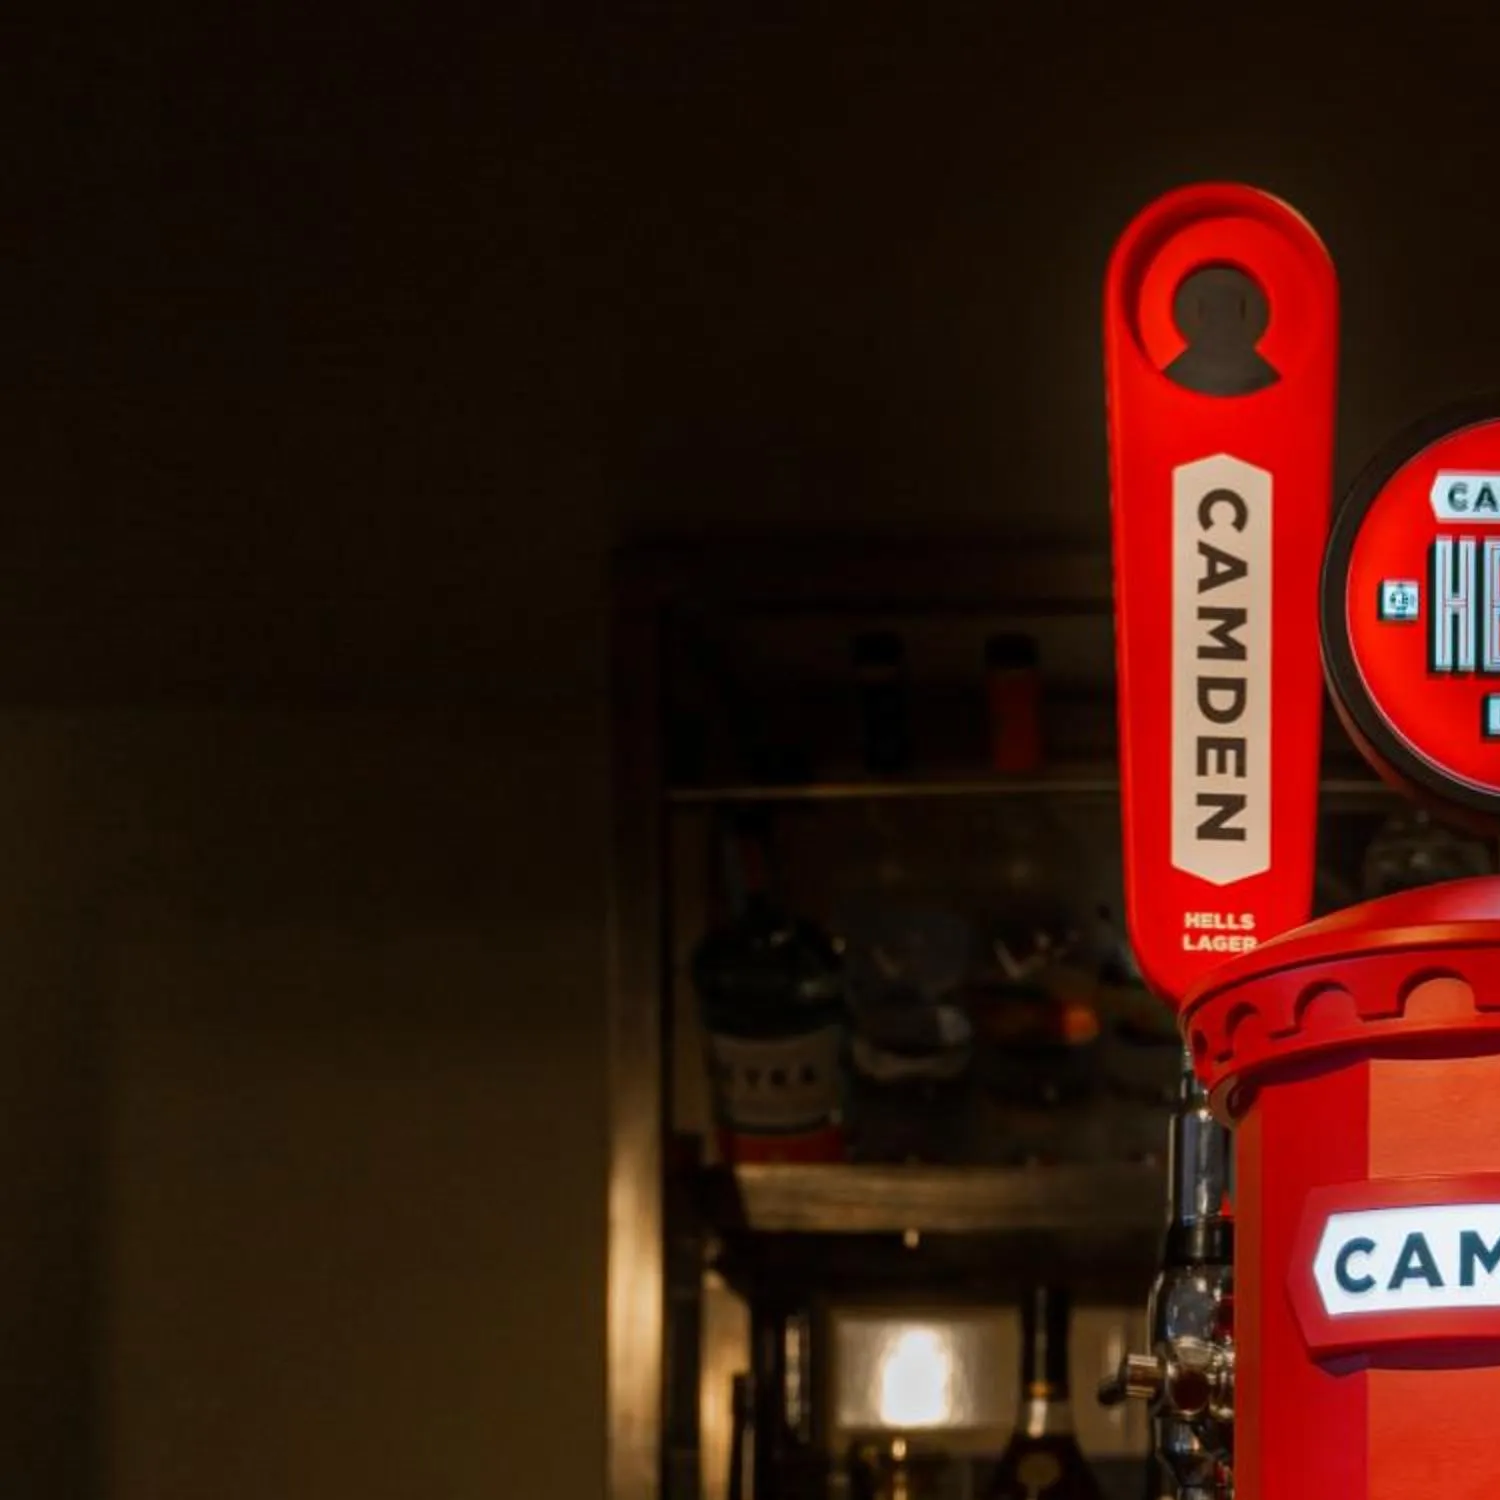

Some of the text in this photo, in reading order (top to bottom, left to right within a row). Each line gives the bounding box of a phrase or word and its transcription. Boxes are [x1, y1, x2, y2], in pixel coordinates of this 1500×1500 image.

[1196, 487, 1249, 842] CAMDEN
[1183, 911, 1256, 930] HELLS
[1182, 932, 1258, 954] LAGER
